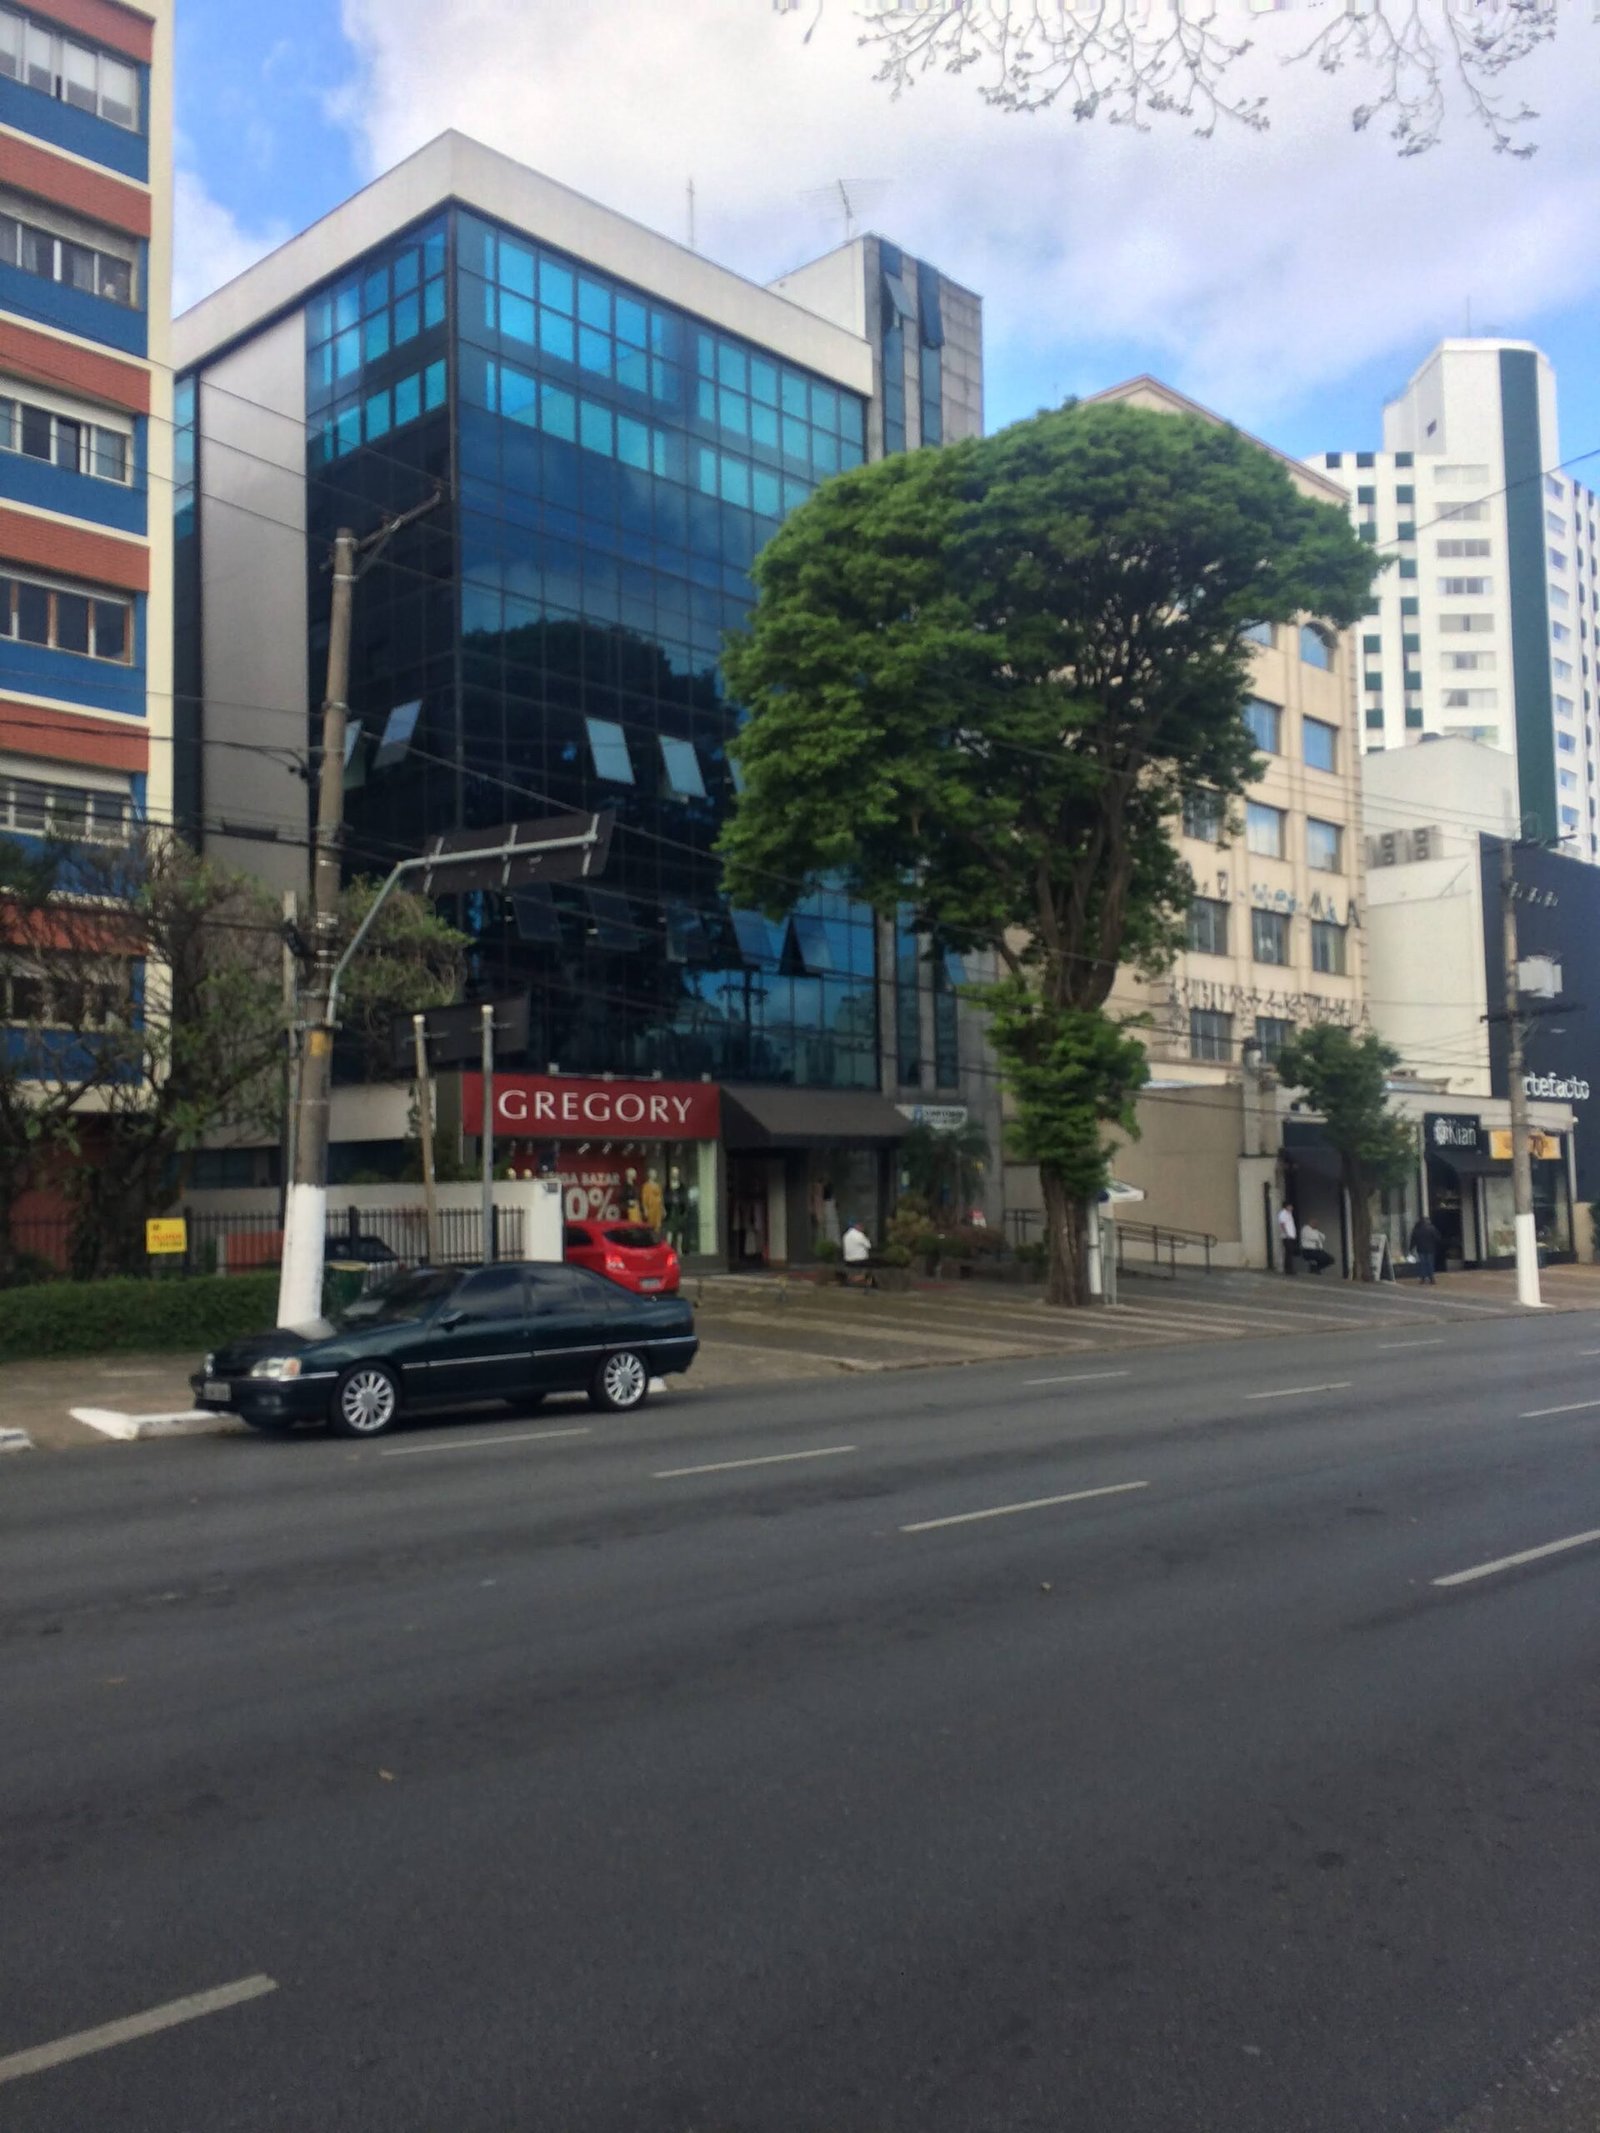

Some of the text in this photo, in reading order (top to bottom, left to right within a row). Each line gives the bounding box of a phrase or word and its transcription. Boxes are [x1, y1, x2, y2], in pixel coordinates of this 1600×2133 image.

[1522, 1071, 1590, 1099] rtefacto
[498, 1089, 692, 1123] GREGORY
[565, 1187, 620, 1221] 0%
